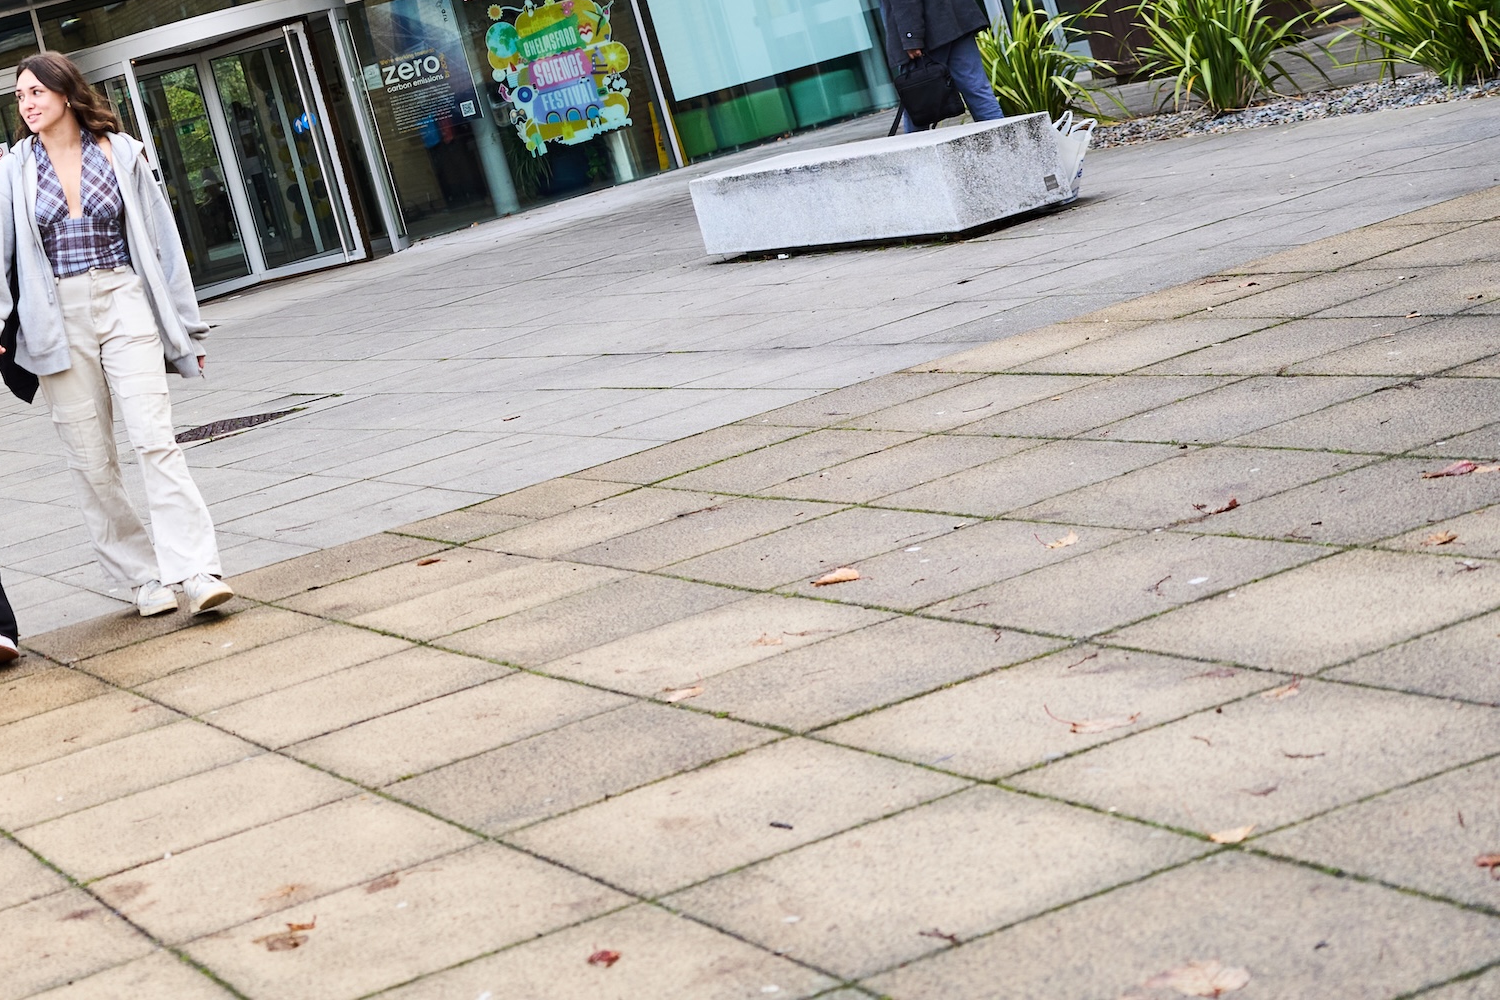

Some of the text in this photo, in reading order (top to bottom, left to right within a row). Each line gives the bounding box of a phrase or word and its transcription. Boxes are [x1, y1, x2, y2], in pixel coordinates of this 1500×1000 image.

[523, 26, 577, 57] CHELMSFORD
[382, 55, 440, 85] zero
[387, 81, 412, 93] carbon
[413, 74, 444, 87] emissions
[533, 52, 586, 87] SCIENCE
[542, 81, 597, 111] FESTIVAL
